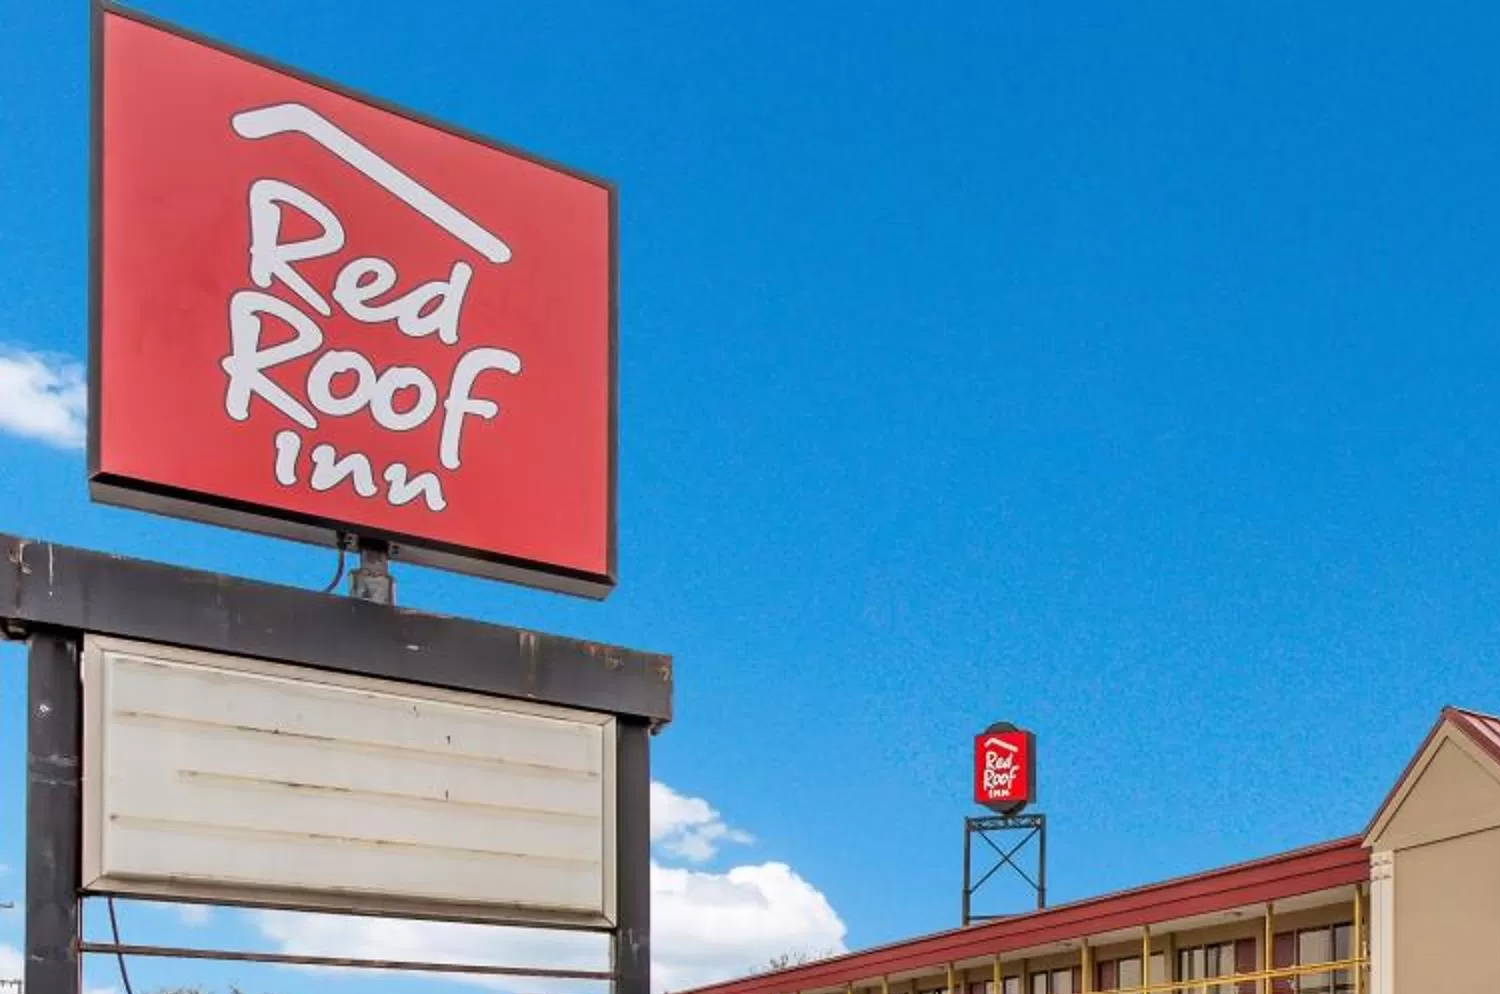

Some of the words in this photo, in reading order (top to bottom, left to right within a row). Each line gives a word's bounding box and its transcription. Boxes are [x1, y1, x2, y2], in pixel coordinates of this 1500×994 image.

[248, 178, 473, 345] Red
[222, 290, 521, 469] Roof
[984, 765, 1020, 791] Roof
[985, 751, 1013, 769] Red
